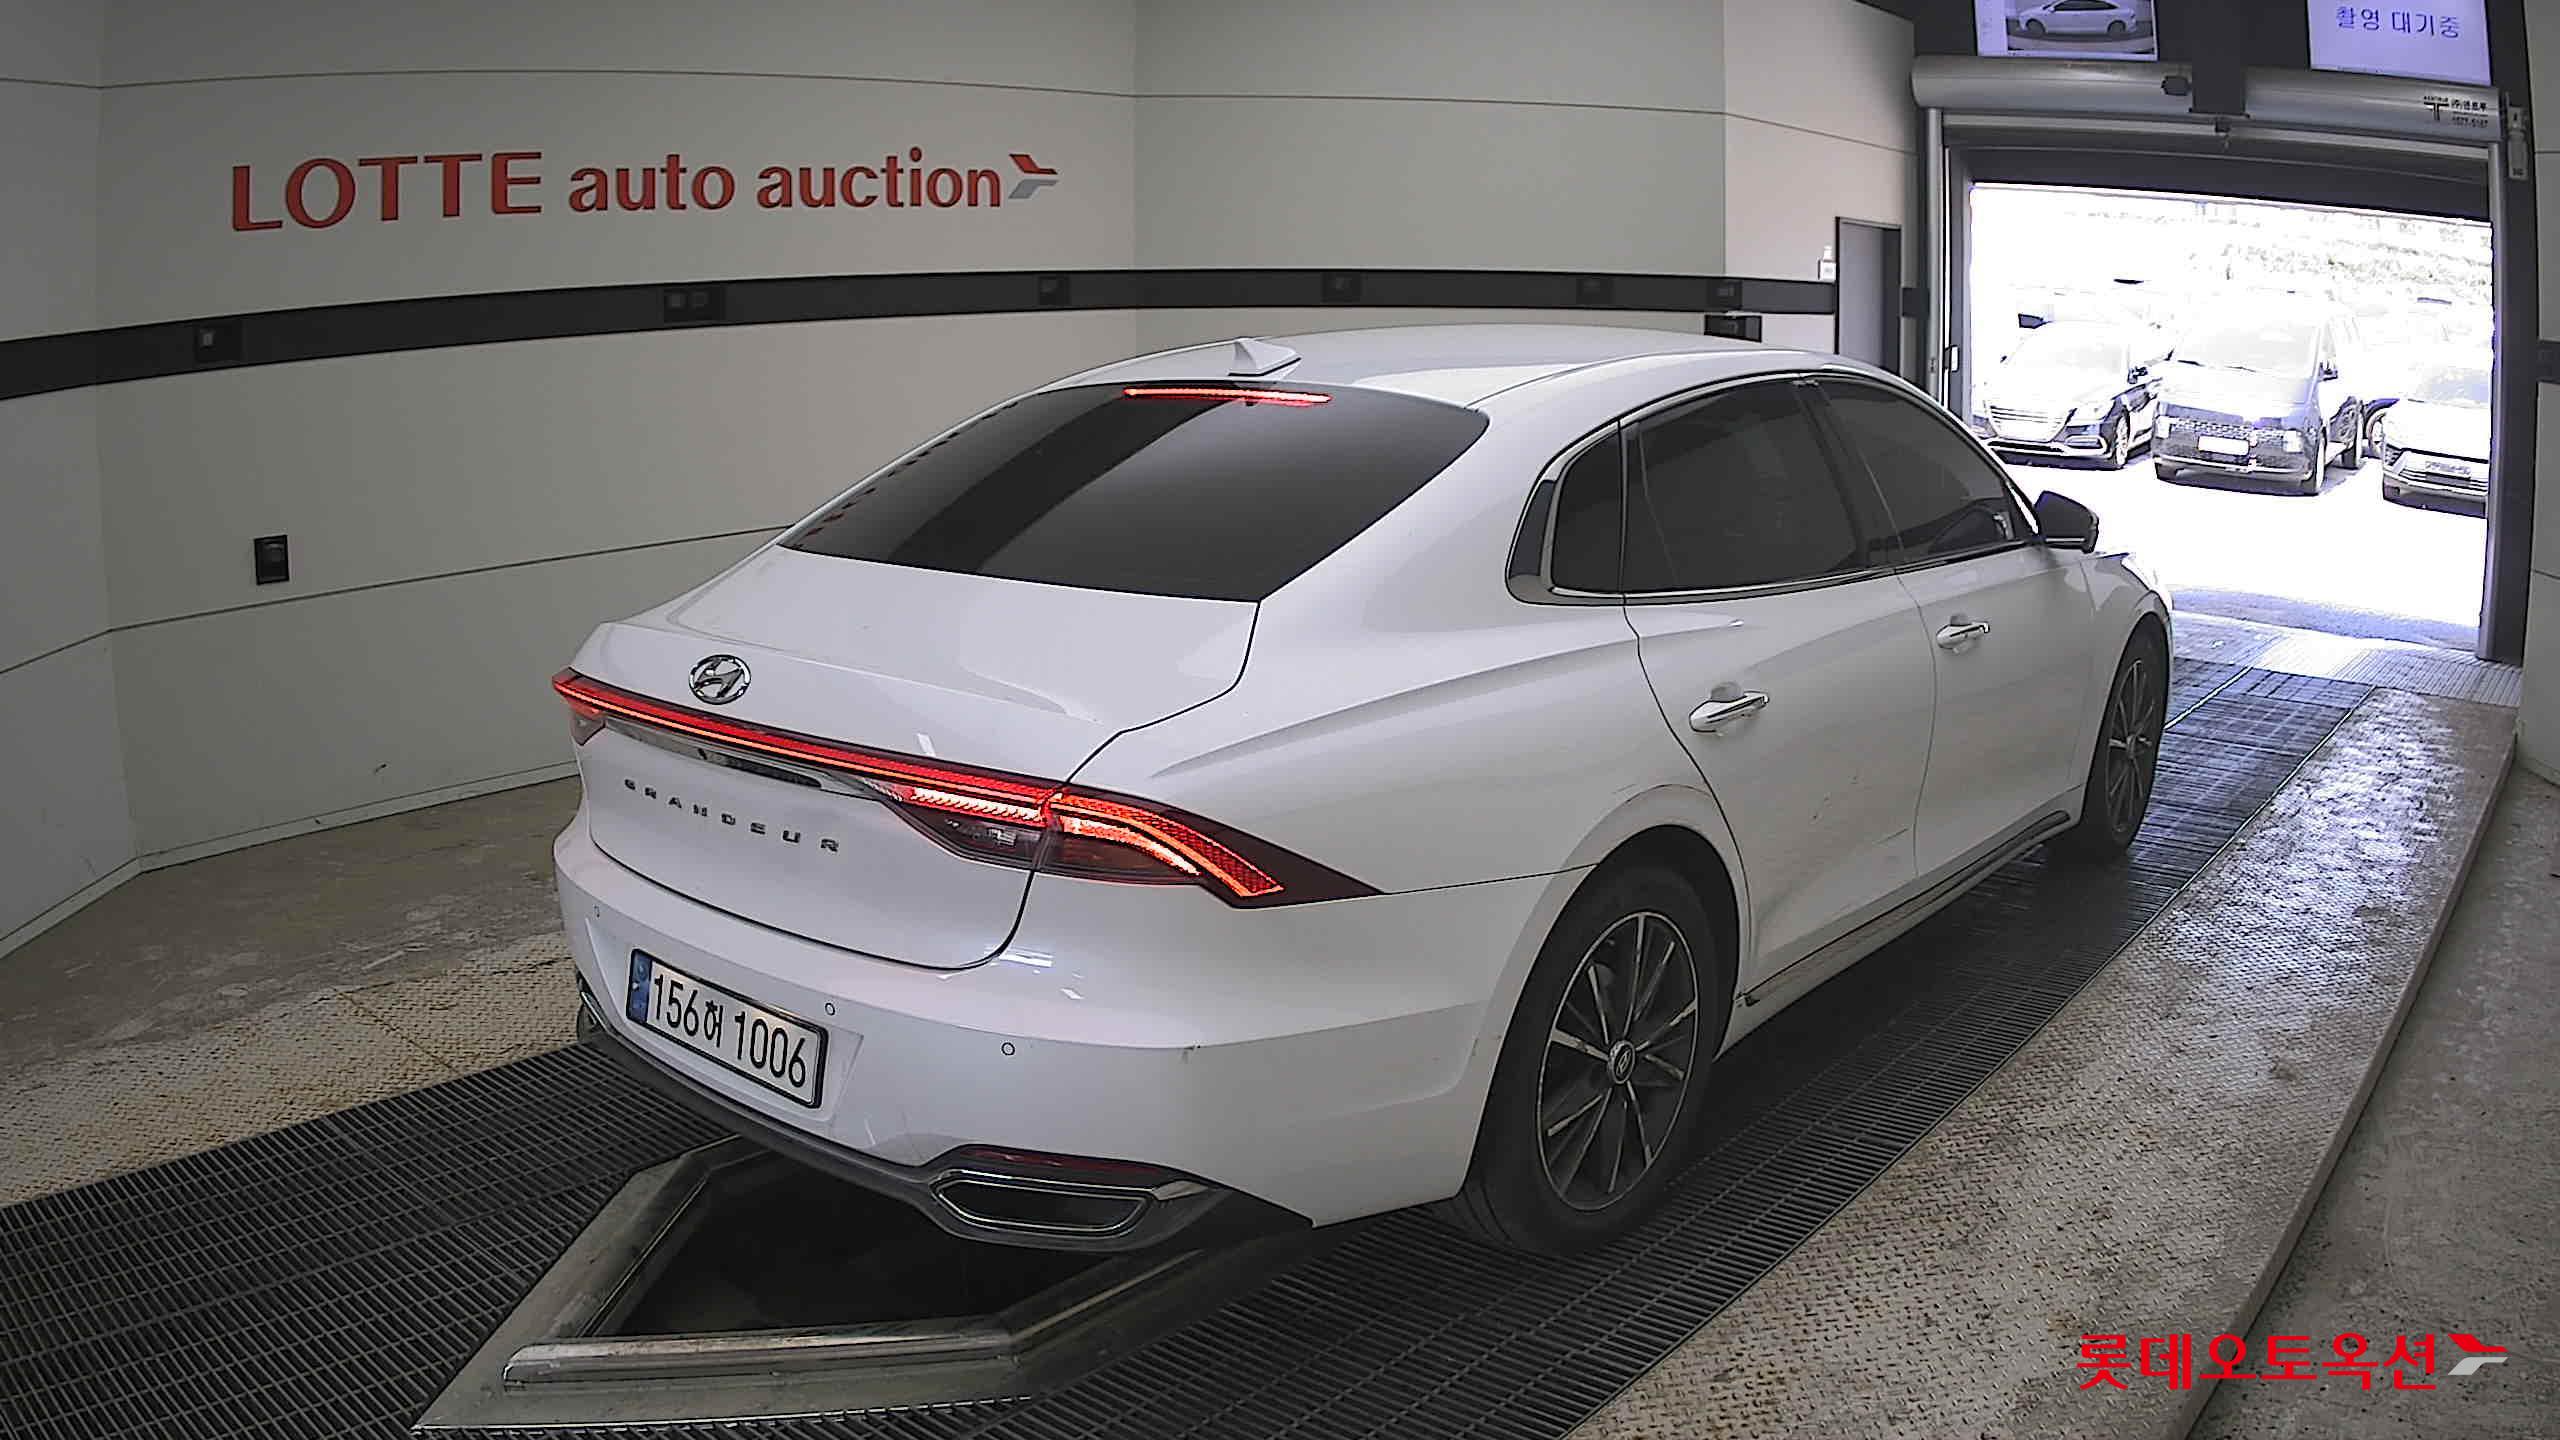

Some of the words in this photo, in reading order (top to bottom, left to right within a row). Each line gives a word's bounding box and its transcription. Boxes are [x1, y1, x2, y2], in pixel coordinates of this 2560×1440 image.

[2336, 6, 2380, 31] 촬영
[2391, 12, 2460, 39] 대기중
[232, 151, 543, 232] LOTTE
[568, 153, 736, 212] auto
[756, 146, 1002, 209] auction
[624, 777, 841, 852] GRANDEUR
[653, 973, 724, 1048] 156허
[734, 1011, 807, 1088] 1006
